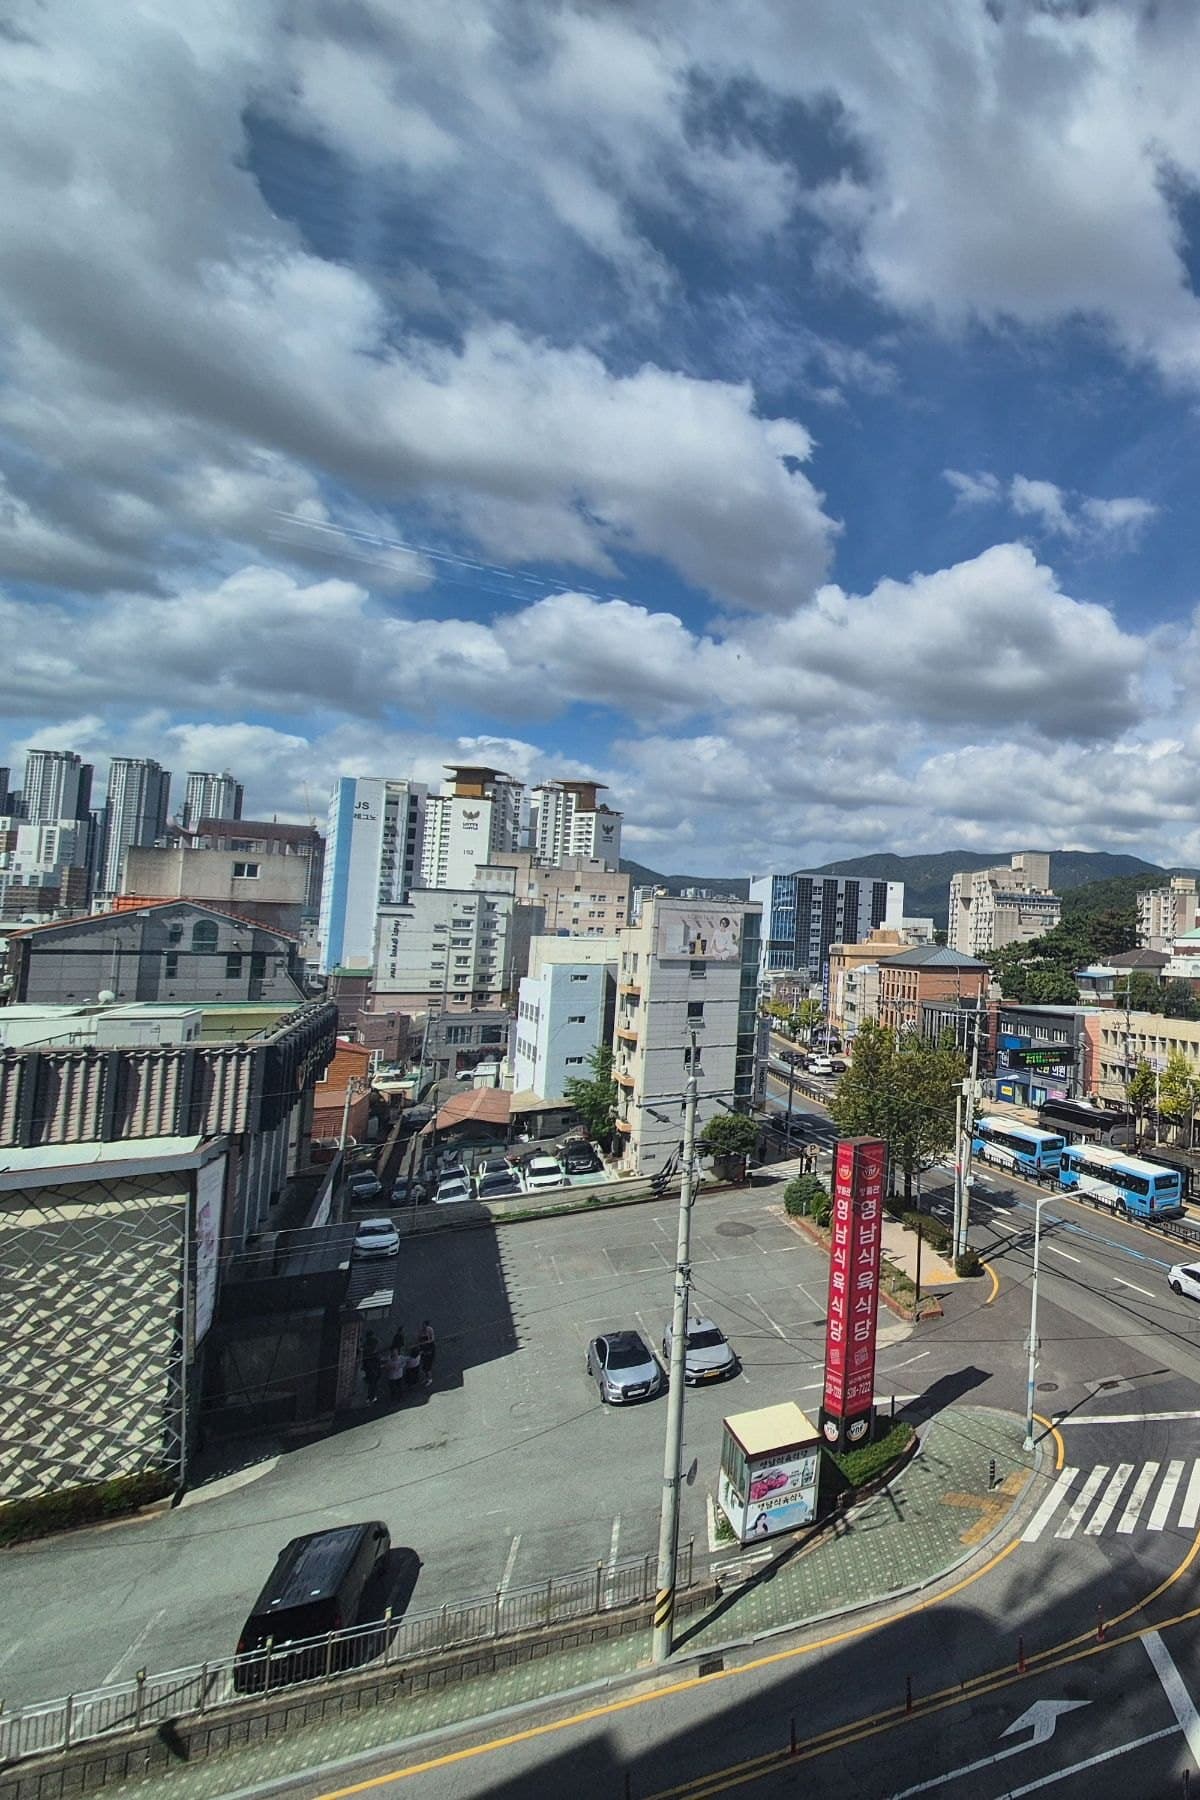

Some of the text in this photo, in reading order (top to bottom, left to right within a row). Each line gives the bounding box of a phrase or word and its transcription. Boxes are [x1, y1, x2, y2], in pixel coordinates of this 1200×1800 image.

[354, 801, 370, 810] JS
[830, 1200, 849, 1343] 영남식육식당
[854, 1199, 878, 1342] 영남식육식당
